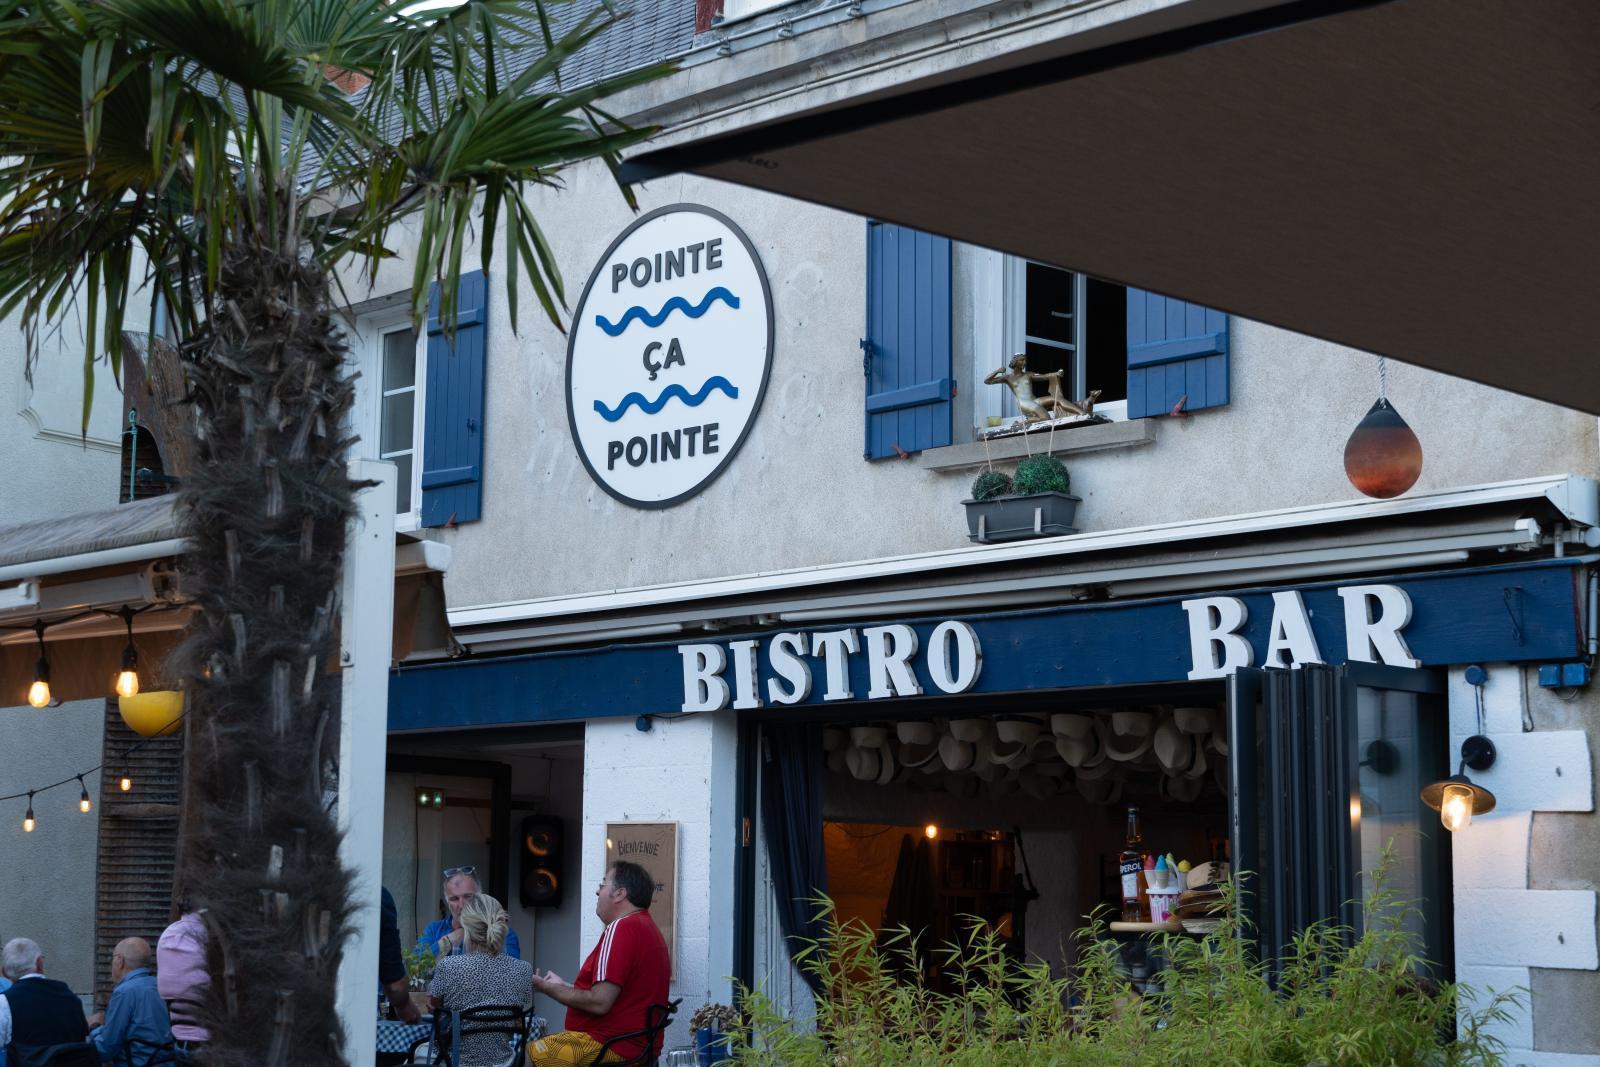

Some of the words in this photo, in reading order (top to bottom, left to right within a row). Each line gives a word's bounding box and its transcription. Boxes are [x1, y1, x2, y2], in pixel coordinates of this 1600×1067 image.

[611, 237, 723, 293] POINTE
[642, 337, 686, 381] ÇA
[607, 422, 720, 471] POINTE
[678, 620, 983, 712] BISTRO
[1181, 584, 1422, 680] BAR
[1120, 862, 1142, 874] PEROL
